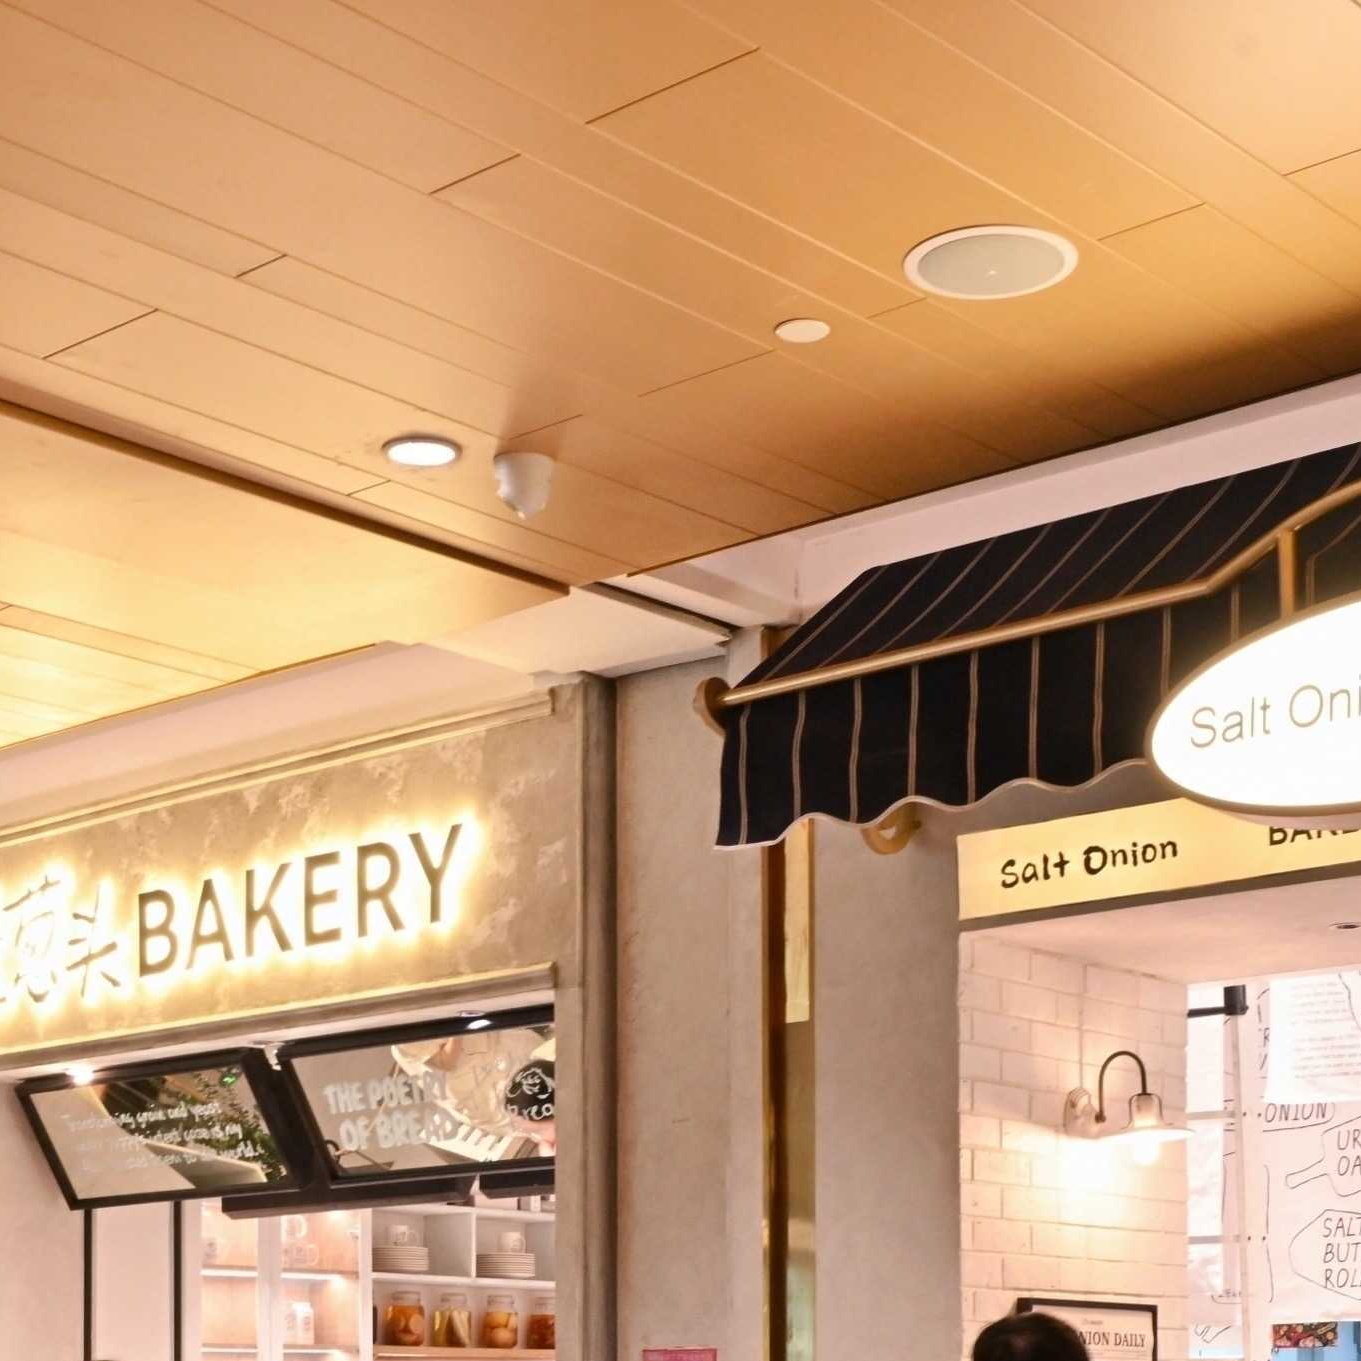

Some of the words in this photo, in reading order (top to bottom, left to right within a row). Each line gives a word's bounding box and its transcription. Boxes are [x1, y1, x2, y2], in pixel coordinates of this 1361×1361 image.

[1189, 697, 1271, 751] Salt
[1268, 826, 1359, 846] BAK
[999, 849, 1070, 889] Salt
[1083, 834, 1179, 876] Onion
[137, 822, 465, 977] BAKERY
[324, 1080, 364, 1115] THE
[339, 1117, 370, 1151] OF
[376, 1104, 462, 1149] BREAD
[1077, 1331, 1110, 1346] NION
[1114, 1332, 1146, 1348] DAILY
